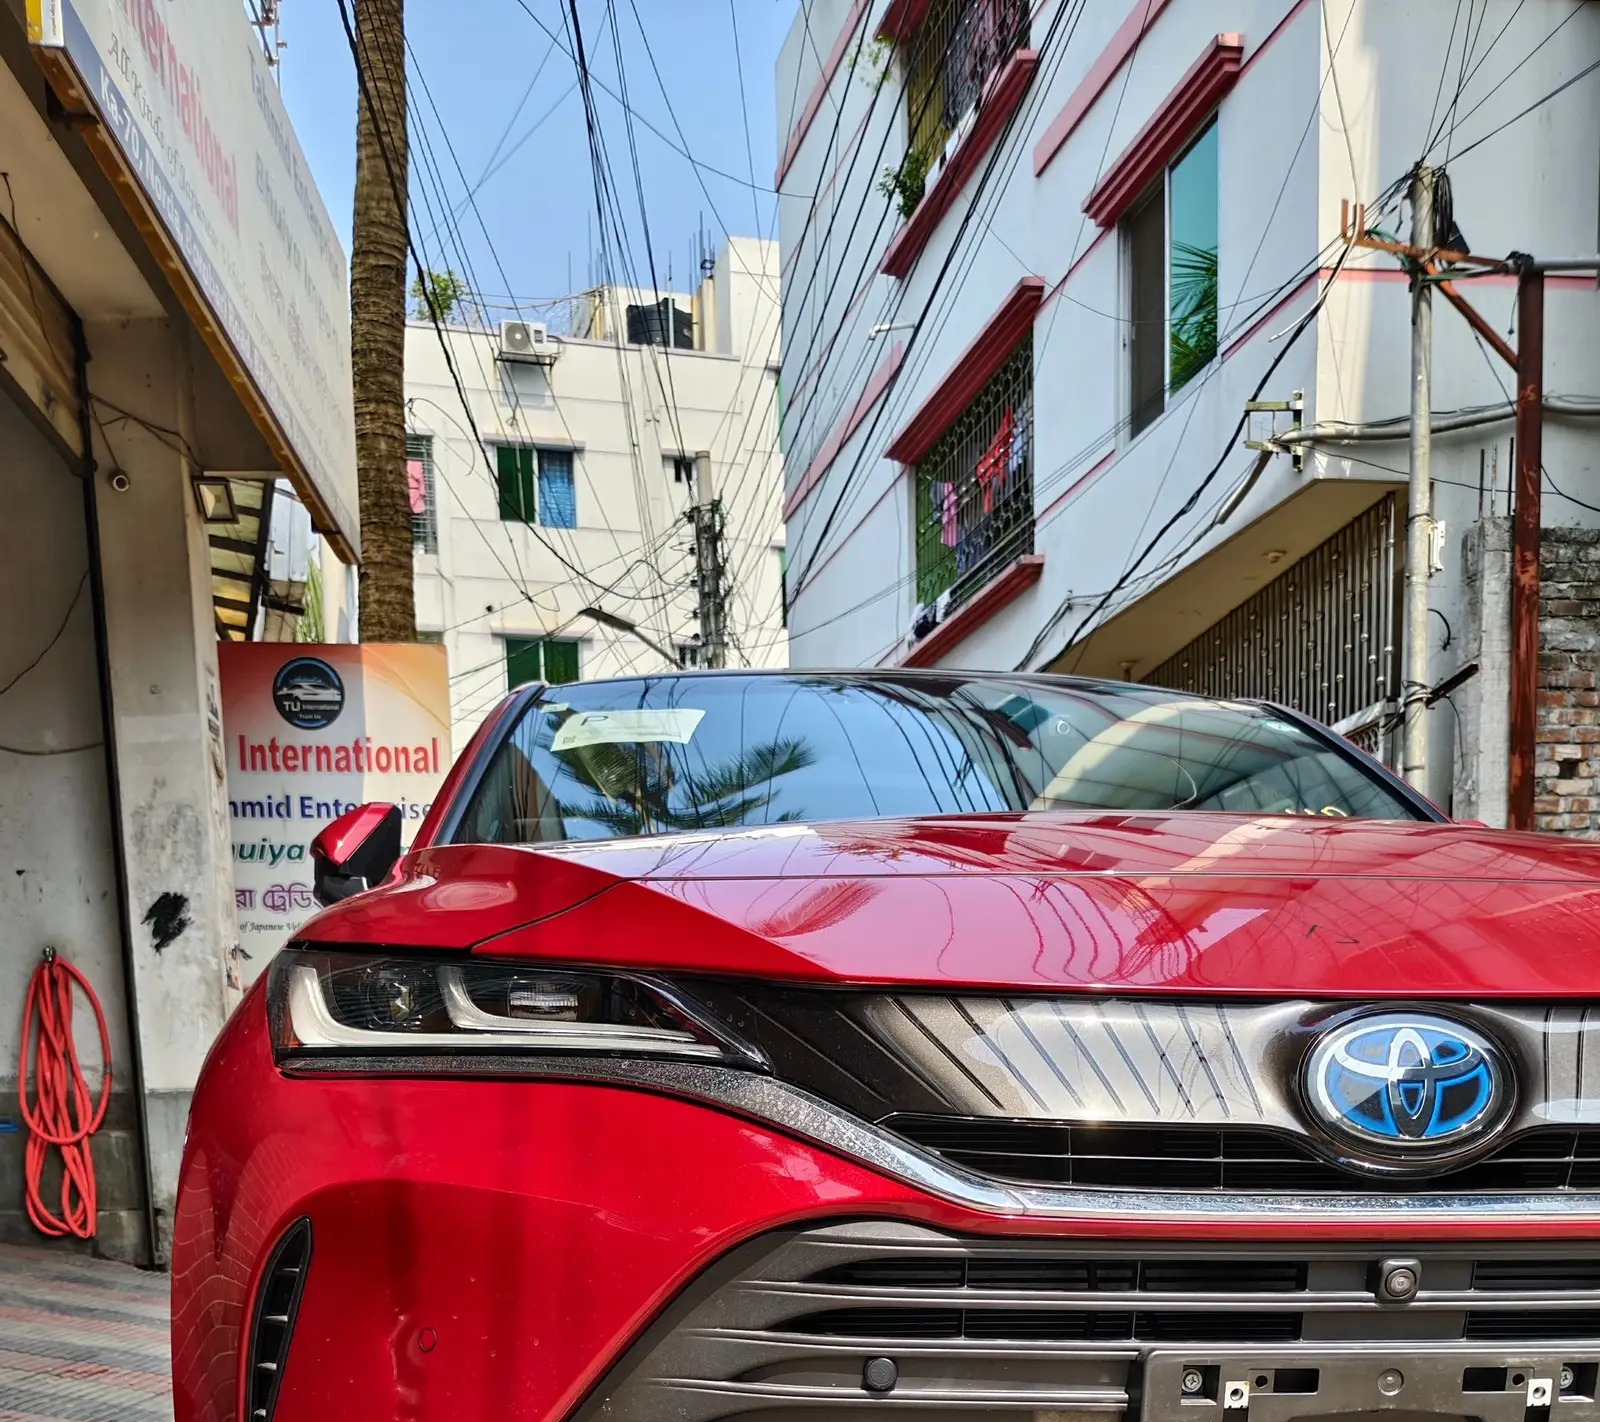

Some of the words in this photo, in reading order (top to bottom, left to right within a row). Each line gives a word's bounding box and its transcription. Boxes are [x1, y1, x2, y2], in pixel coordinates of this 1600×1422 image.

[100, 66, 143, 171] Ka-70,
[107, 32, 131, 82] All
[131, 70, 164, 149] Kinds
[167, 146, 180, 177] of
[247, 43, 292, 178] Tahmid
[283, 701, 300, 711] TU
[239, 735, 440, 773] International
[239, 921, 248, 934] of
[250, 922, 283, 934] Japanese
